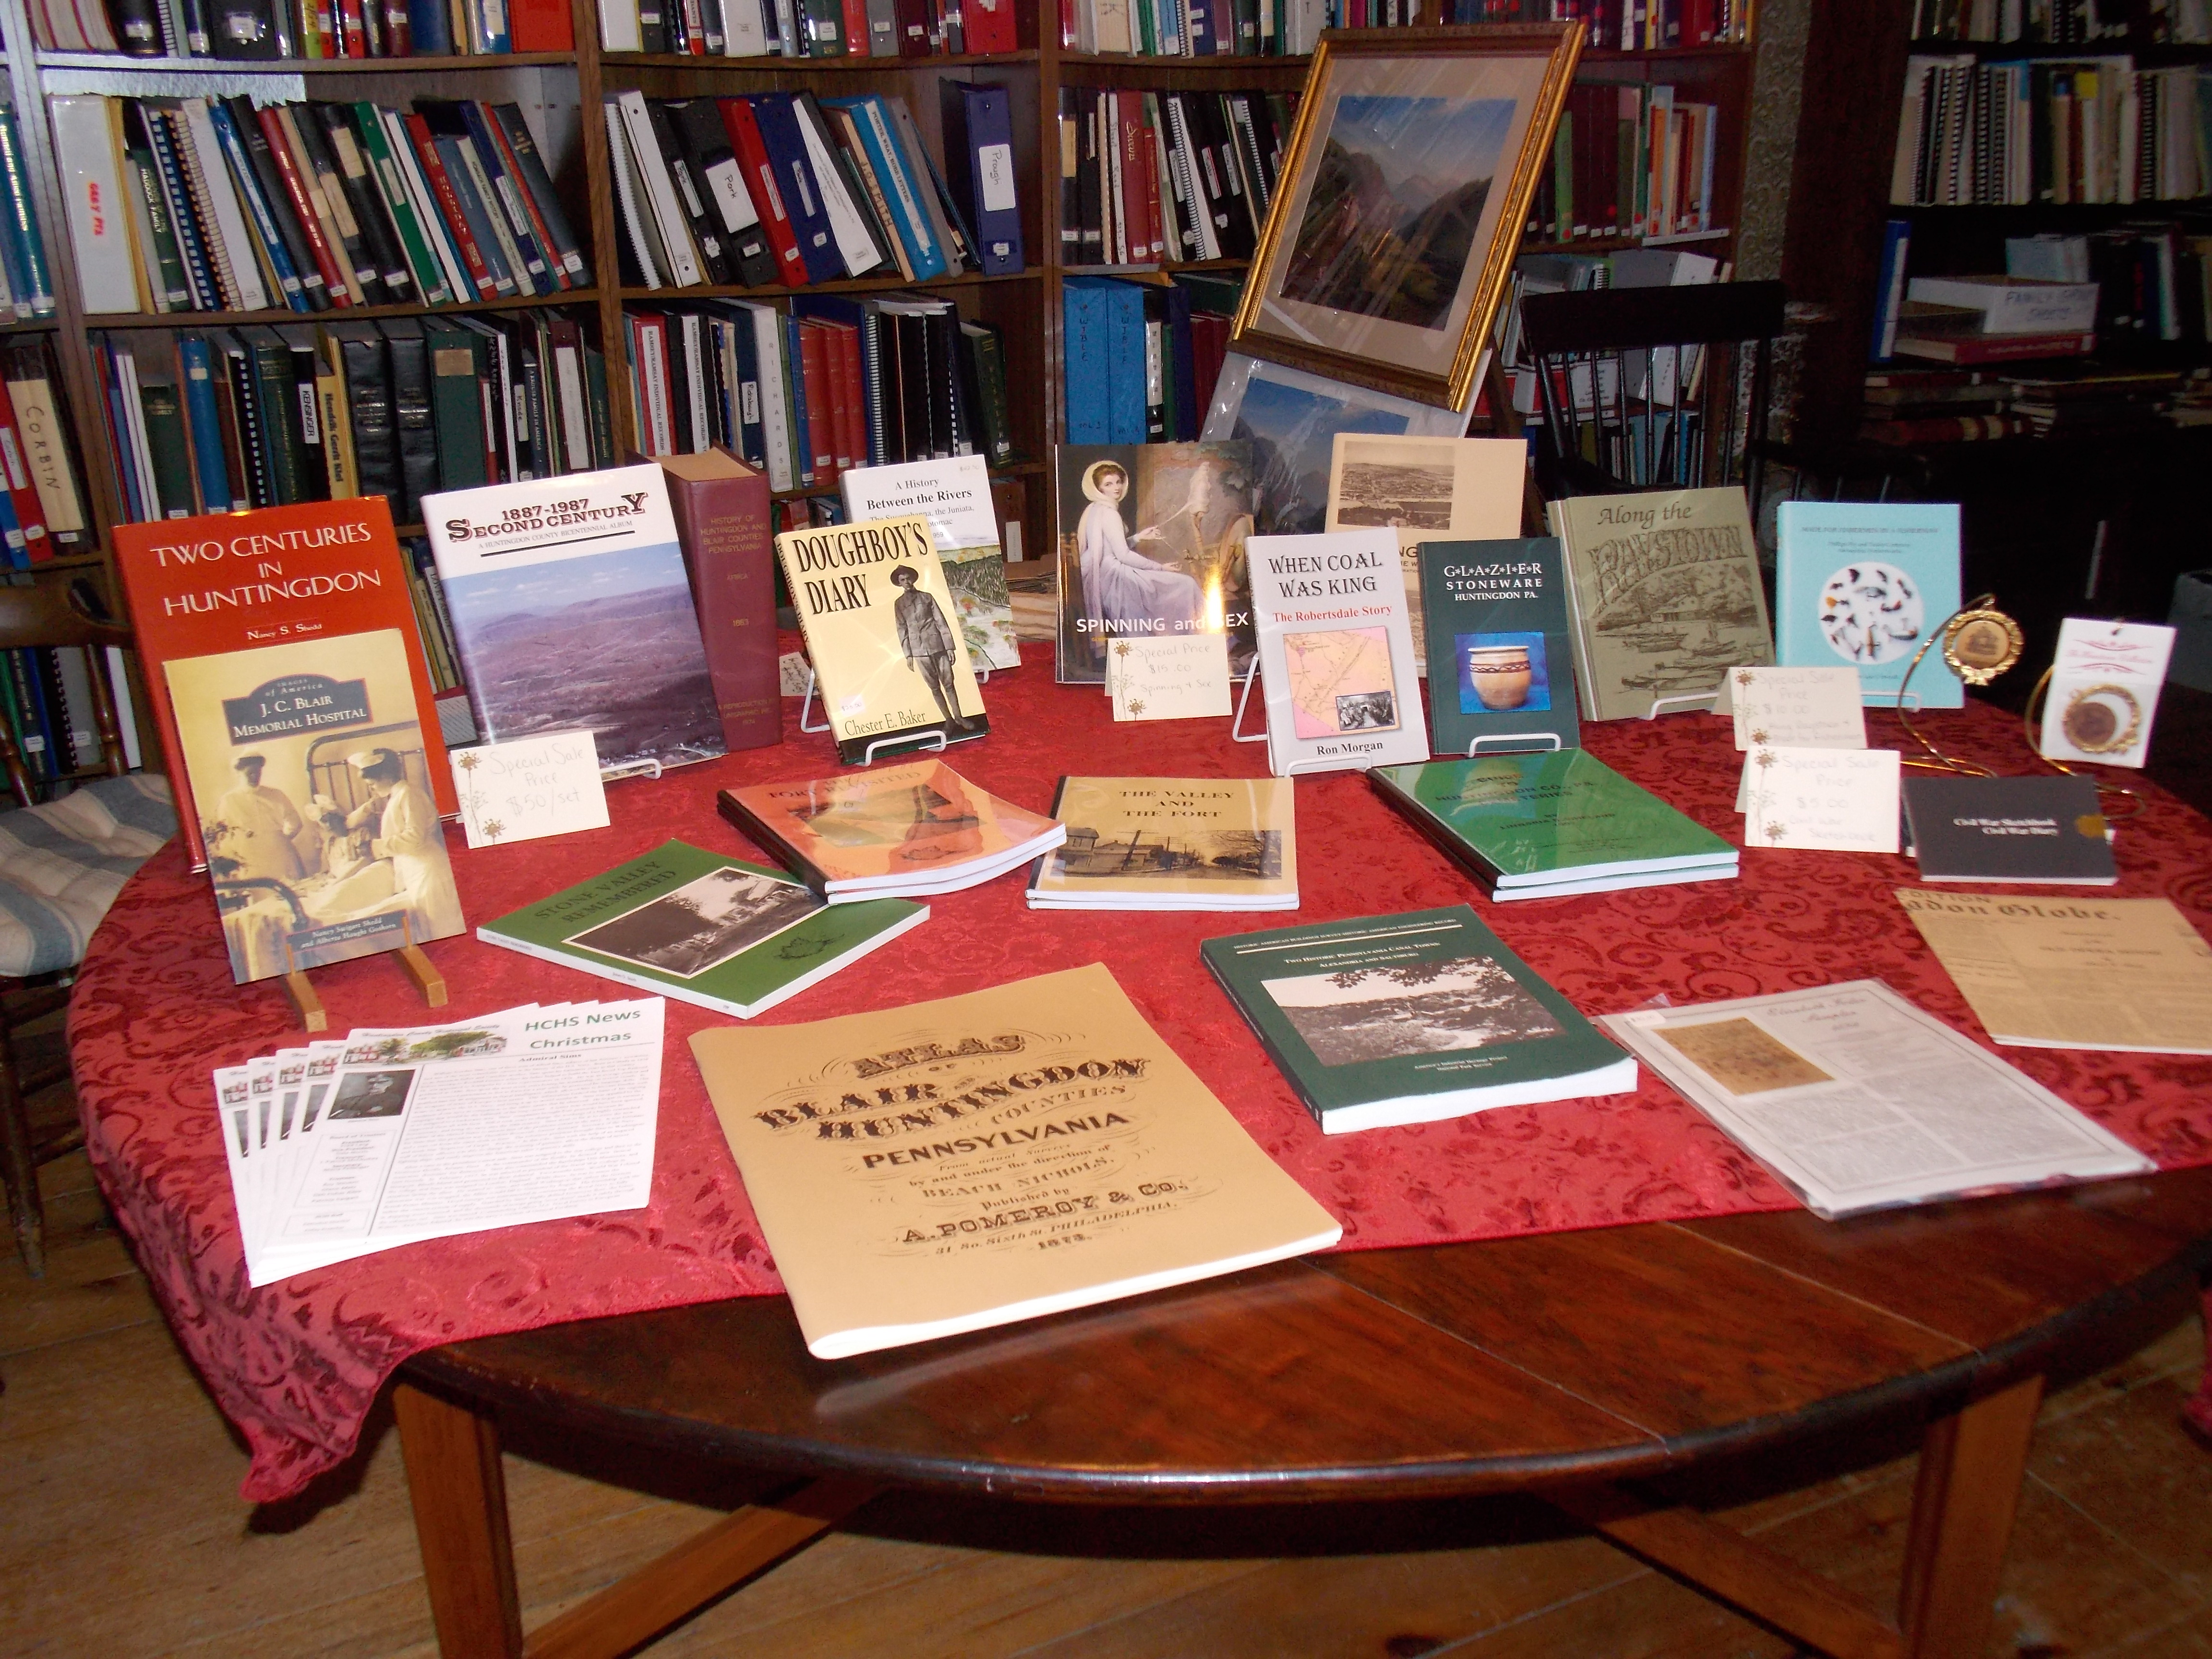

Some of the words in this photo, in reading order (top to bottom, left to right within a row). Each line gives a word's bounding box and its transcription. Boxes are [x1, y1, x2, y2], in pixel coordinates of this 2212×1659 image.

[990, 149, 1002, 185] Prough
[725, 174, 737, 199] Park
[897, 176, 910, 203] LETTERS
[140, 169, 156, 203] HADDOCK
[151, 204, 162, 234] FAMILY
[652, 381, 662, 417] INDIVIDUAL
[302, 390, 315, 437] KENSINGER
[26, 406, 60, 489] CORBIN
[895, 481, 902, 490] A
[905, 479, 939, 489] History
[501, 498, 589, 521] 1887-1987
[866, 496, 914, 511] Between
[916, 493, 934, 504] the
[937, 490, 973, 501] Rivers
[948, 505, 974, 514] Juniata,
[445, 518, 543, 543] SECOND
[546, 492, 649, 527] CENTURY
[710, 516, 741, 524] HISTORY
[1597, 505, 1656, 529] Along
[1662, 501, 1692, 520] the
[485, 536, 531, 549] HUNTINGDON
[532, 532, 559, 541] COUNTY
[561, 524, 608, 537] BICENTENNIAL
[610, 520, 633, 529] ALBUM
[700, 525, 748, 535] HUNTINGDON
[752, 522, 767, 530] AND
[703, 537, 724, 545] BLAIR
[728, 533, 764, 543] COUNTIES
[150, 541, 224, 568] TWO
[230, 522, 372, 556] CENTURIES
[709, 543, 761, 554] PENNSYLVANIA
[792, 521, 929, 573] DOUGHBOY'S
[257, 561, 283, 579] IN
[1268, 554, 1322, 574] WHEN
[1327, 551, 1383, 571] COAL
[163, 569, 382, 617] HUNTINGDON
[804, 574, 872, 615] DIARY
[1278, 578, 1322, 598] WAS
[1327, 576, 1377, 595] KING
[1446, 577, 1542, 591] STONEWARE
[1454, 590, 1521, 601] HUNTINGDON
[1524, 590, 1539, 599] PA.
[1076, 618, 1166, 633] SPINNING
[1174, 619, 1206, 631] and
[1273, 612, 1293, 623] The
[1295, 608, 1359, 622] Robertsdale
[1362, 605, 1392, 616] Story
[247, 628, 276, 640] Nancy
[280, 625, 291, 635] S.
[295, 623, 323, 633] Shedd
[797, 612, 810, 644] DIARY
[1135, 646, 1177, 663] Special
[1183, 643, 1210, 654] Price
[265, 688, 275, 697] of
[281, 683, 323, 694] America
[1141, 683, 1182, 697] Spinning
[1196, 679, 1212, 689] Sex
[261, 704, 270, 717] J.
[275, 700, 289, 713] C.
[295, 696, 334, 709] BLAIR
[233, 718, 303, 739] MEMORIAL
[306, 708, 367, 727] HOSPITAL
[844, 719, 884, 736] Chester
[884, 712, 898, 729] E.
[897, 709, 927, 727] Baker
[489, 750, 550, 778] Special
[553, 743, 585, 764] Sale
[1316, 745, 1338, 756] Ron
[1341, 741, 1383, 757] Morgan
[524, 772, 558, 787] Price
[505, 787, 580, 817] $50/set
[769, 787, 815, 798] FORT
[1119, 790, 1157, 798] THE
[1164, 790, 1235, 799] VALLEY
[1172, 810, 1223, 818] FORT
[1952, 818, 1978, 826] Civil
[1978, 818, 2000, 826] War
[534, 891, 599, 920] STONE
[595, 860, 663, 893] VALLEY
[561, 869, 677, 924] REMEMBERED
[1302, 954, 1335, 962] HISTORIC
[1337, 948, 1389, 958] PENNSYLVANIA
[1319, 959, 1363, 968] ALEXANDRIA
[1379, 952, 1419, 961] SALTSBURG
[525, 1016, 580, 1032] HCHS
[587, 1010, 641, 1025] News
[530, 1031, 632, 1050] Christmas
[851, 1034, 1026, 1079] ATLAS
[752, 1082, 944, 1133] BLAIR
[813, 1056, 1151, 1142] HUNTINGDON
[990, 1084, 1127, 1125] COUNTIES
[863, 1109, 1130, 1169] PENNSYLVANIA
[909, 1179, 926, 1188] by
[932, 1173, 958, 1183] and
[963, 1166, 1003, 1178] under
[1033, 1149, 1093, 1166] direction
[1098, 1144, 1111, 1153] of
[939, 1162, 969, 1172] From
[978, 1153, 1016, 1165] actual
[922, 1182, 1004, 1198] BEACH
[981, 1191, 1050, 1211] Published
[1054, 1188, 1070, 1196] by
[902, 1228, 937, 1244] A.
[936, 1194, 1100, 1238] POMEROY
[1107, 1190, 1132, 1204] &
[1137, 1181, 1189, 1197] CO.
[986, 1232, 1026, 1247] Sixth
[1049, 1202, 1178, 1233] PHILADELPHIA.
